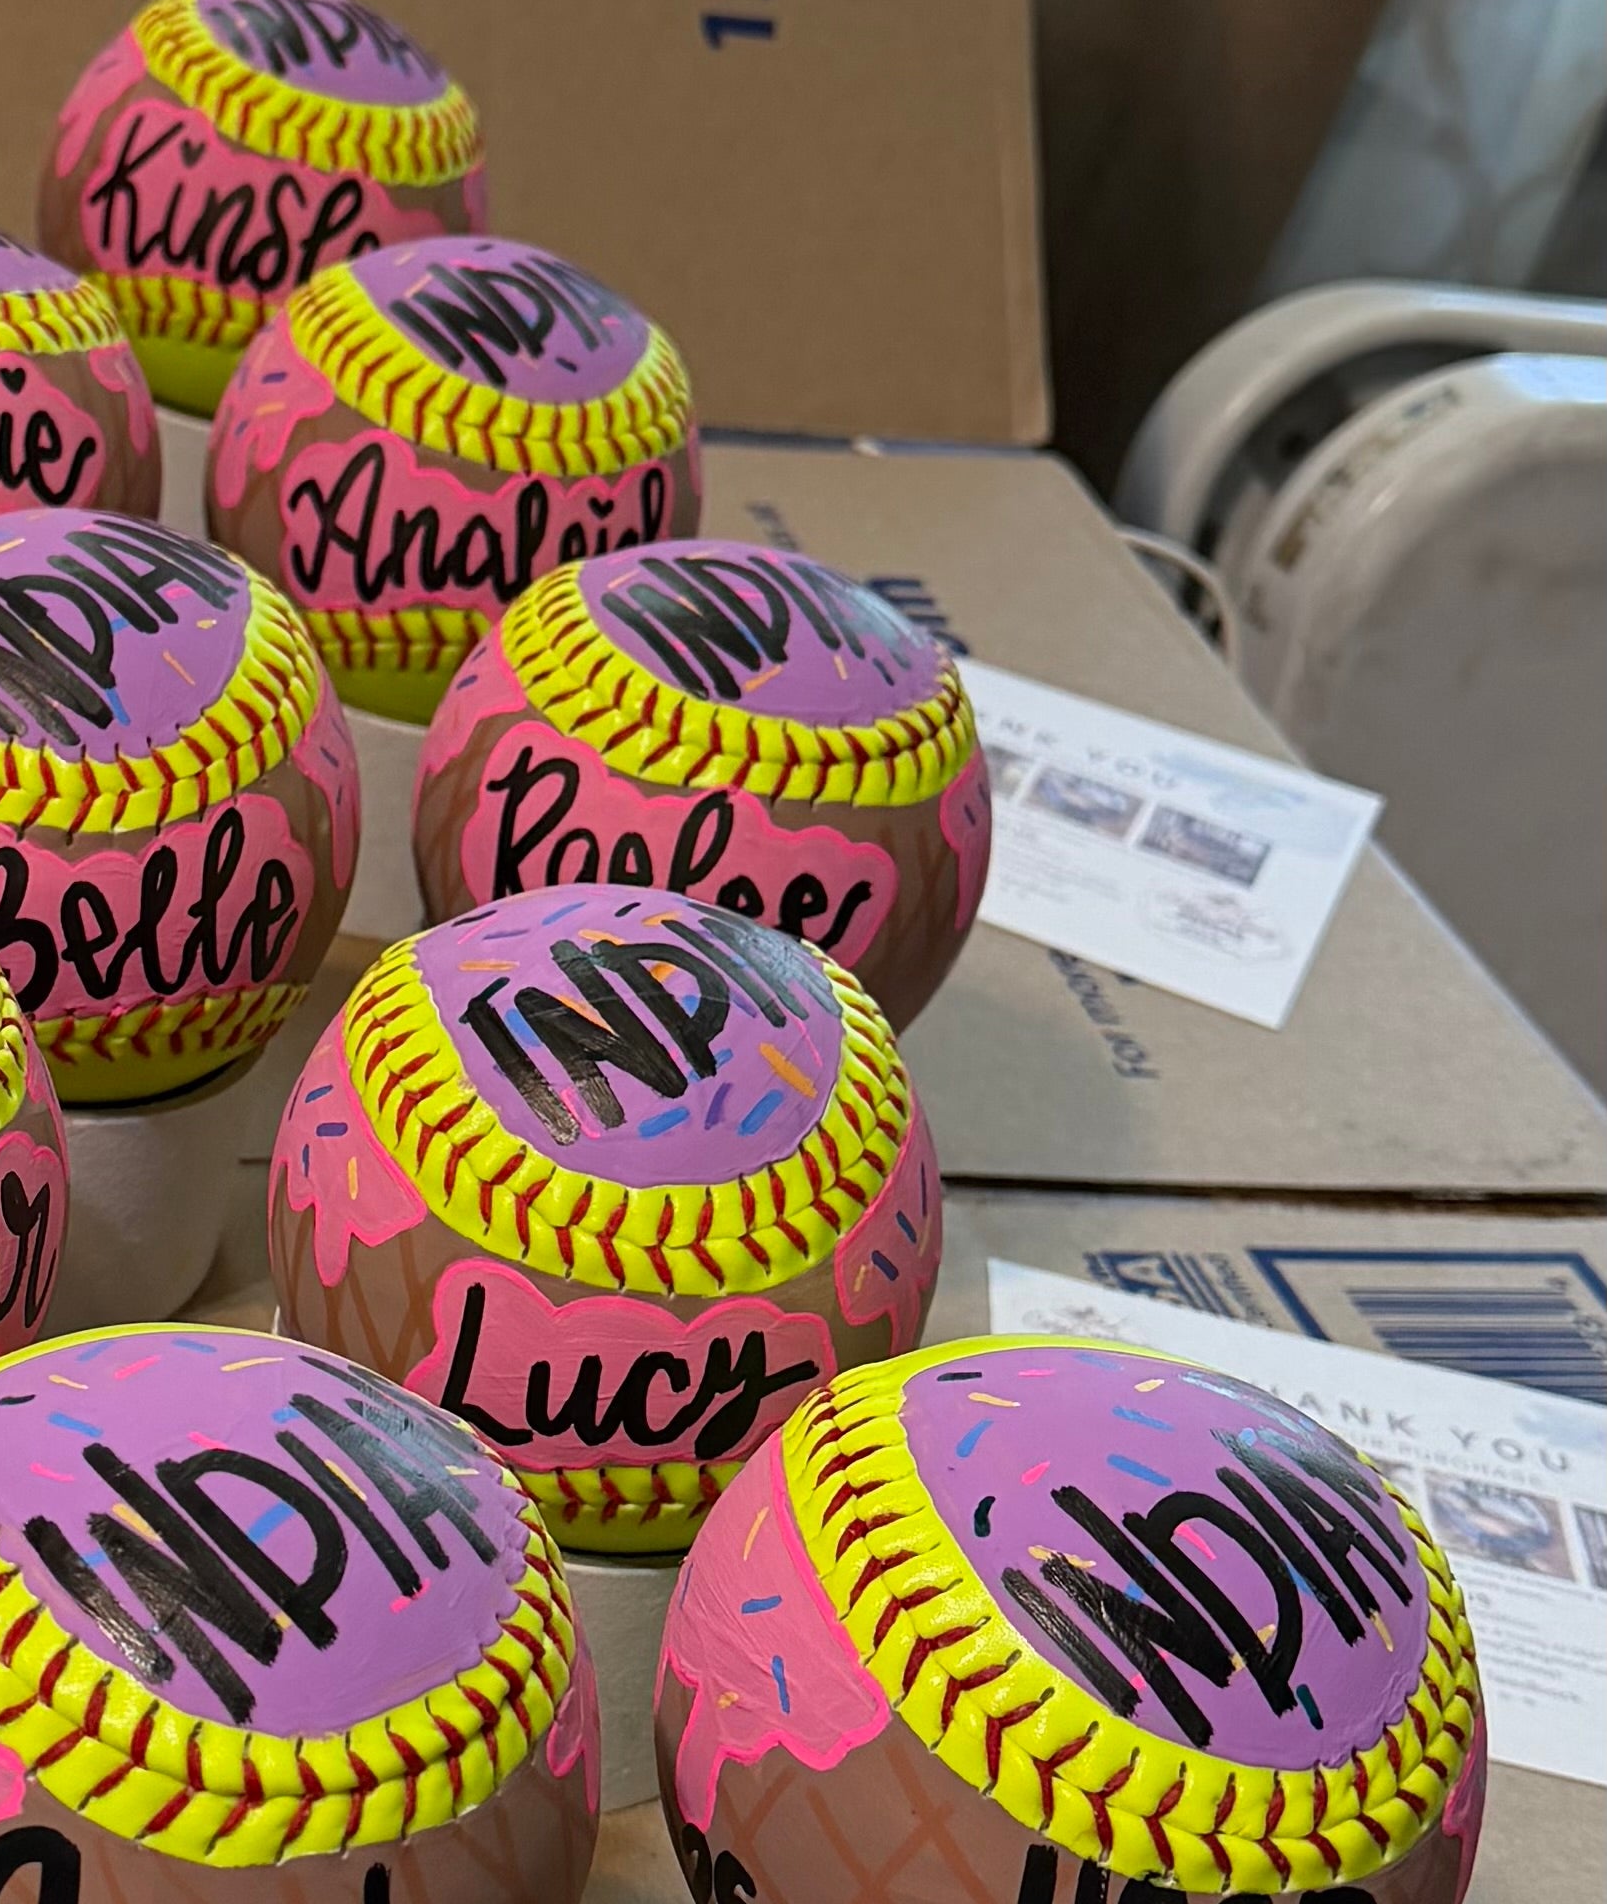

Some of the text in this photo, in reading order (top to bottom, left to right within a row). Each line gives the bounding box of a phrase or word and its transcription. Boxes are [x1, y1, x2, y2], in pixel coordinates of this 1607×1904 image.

[89, 114, 380, 294] Kinsl
[439, 1282, 821, 1459] Lucy
[1267, 1382, 1572, 1473] ANK YOU
